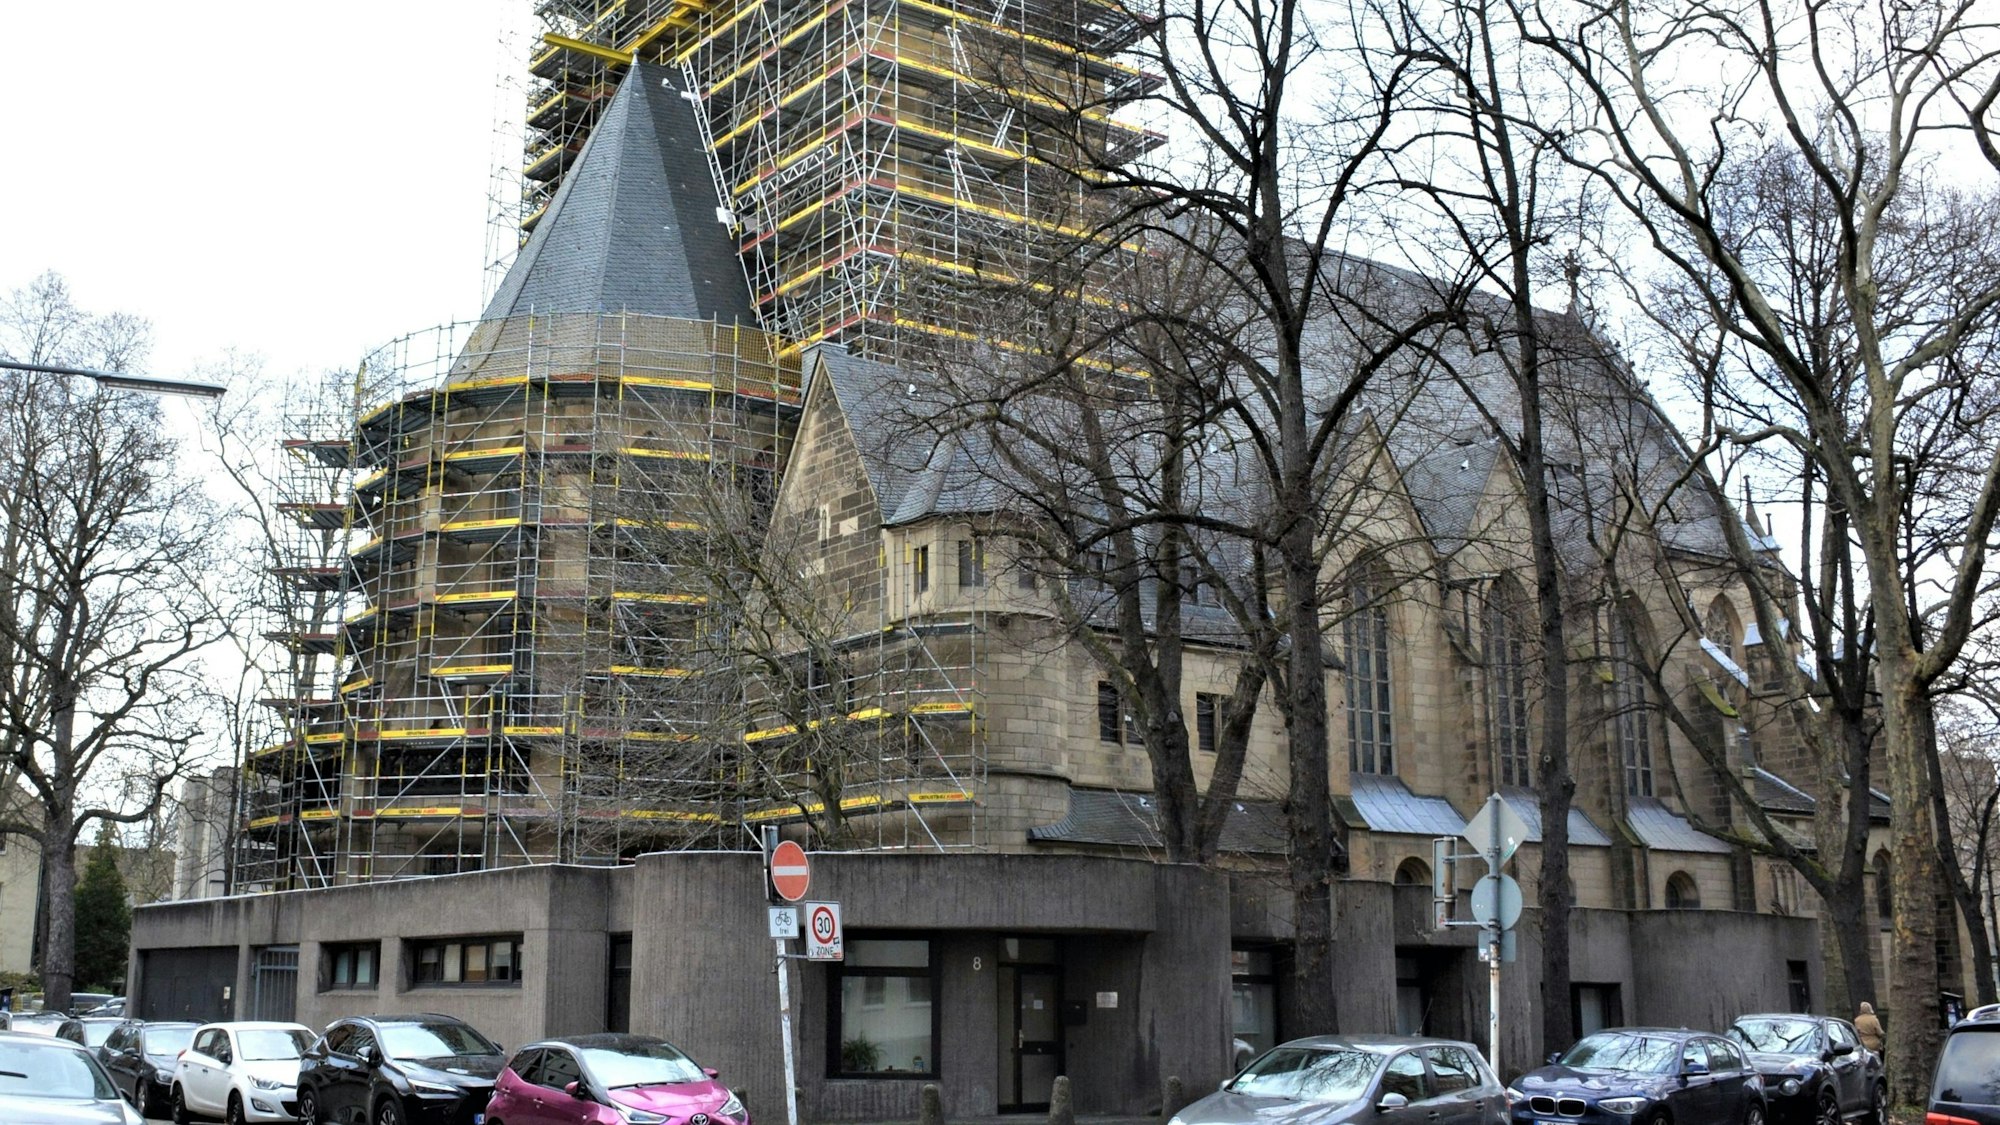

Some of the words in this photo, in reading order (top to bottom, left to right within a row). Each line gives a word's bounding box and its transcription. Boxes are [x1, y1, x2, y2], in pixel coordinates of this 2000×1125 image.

[817, 916, 831, 934] 30
[816, 946, 834, 956] ZONE
[972, 956, 982, 971] 8
